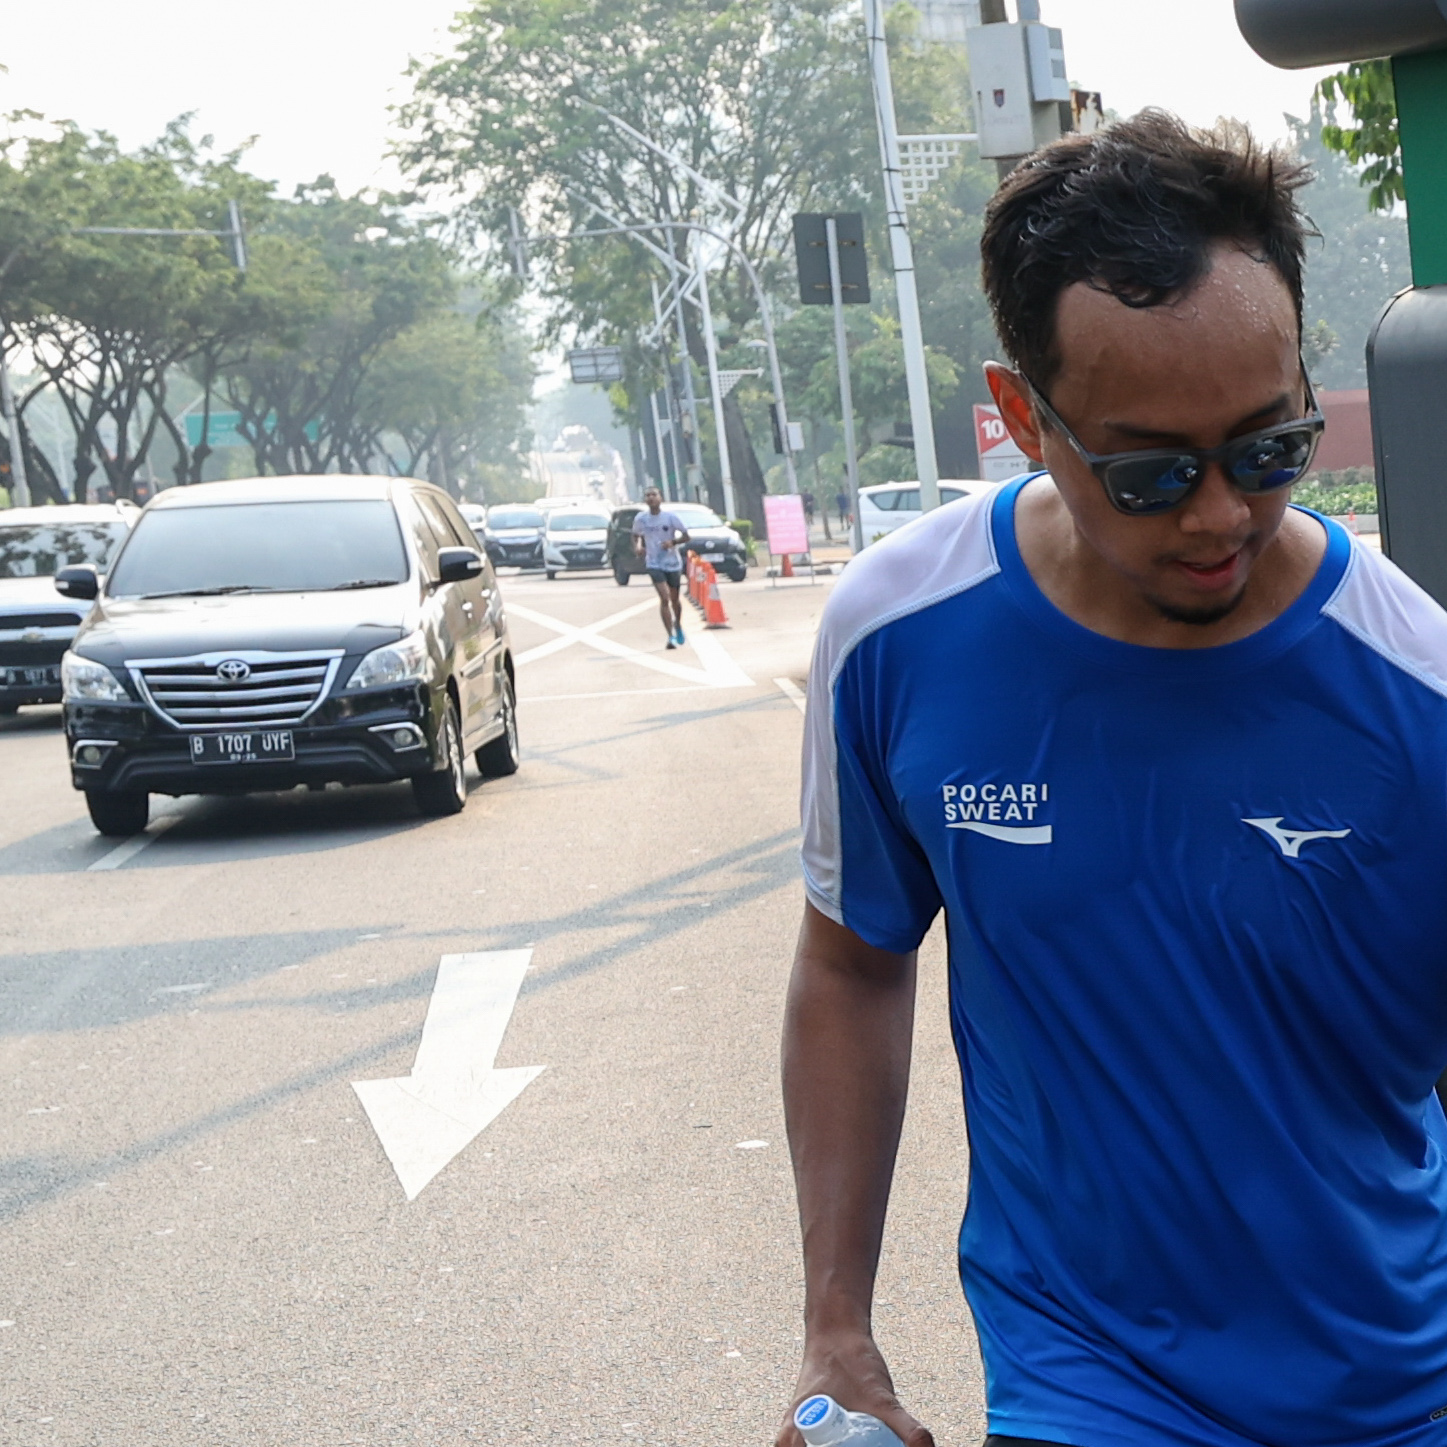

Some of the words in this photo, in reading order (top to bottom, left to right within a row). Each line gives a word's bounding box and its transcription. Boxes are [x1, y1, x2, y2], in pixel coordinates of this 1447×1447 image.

[981, 419, 1004, 439] 10
[193, 736, 205, 755] B
[218, 734, 252, 753] 1707
[261, 732, 290, 751] UYF
[943, 783, 1048, 802] POCARI
[944, 803, 1038, 821] SWEAT
